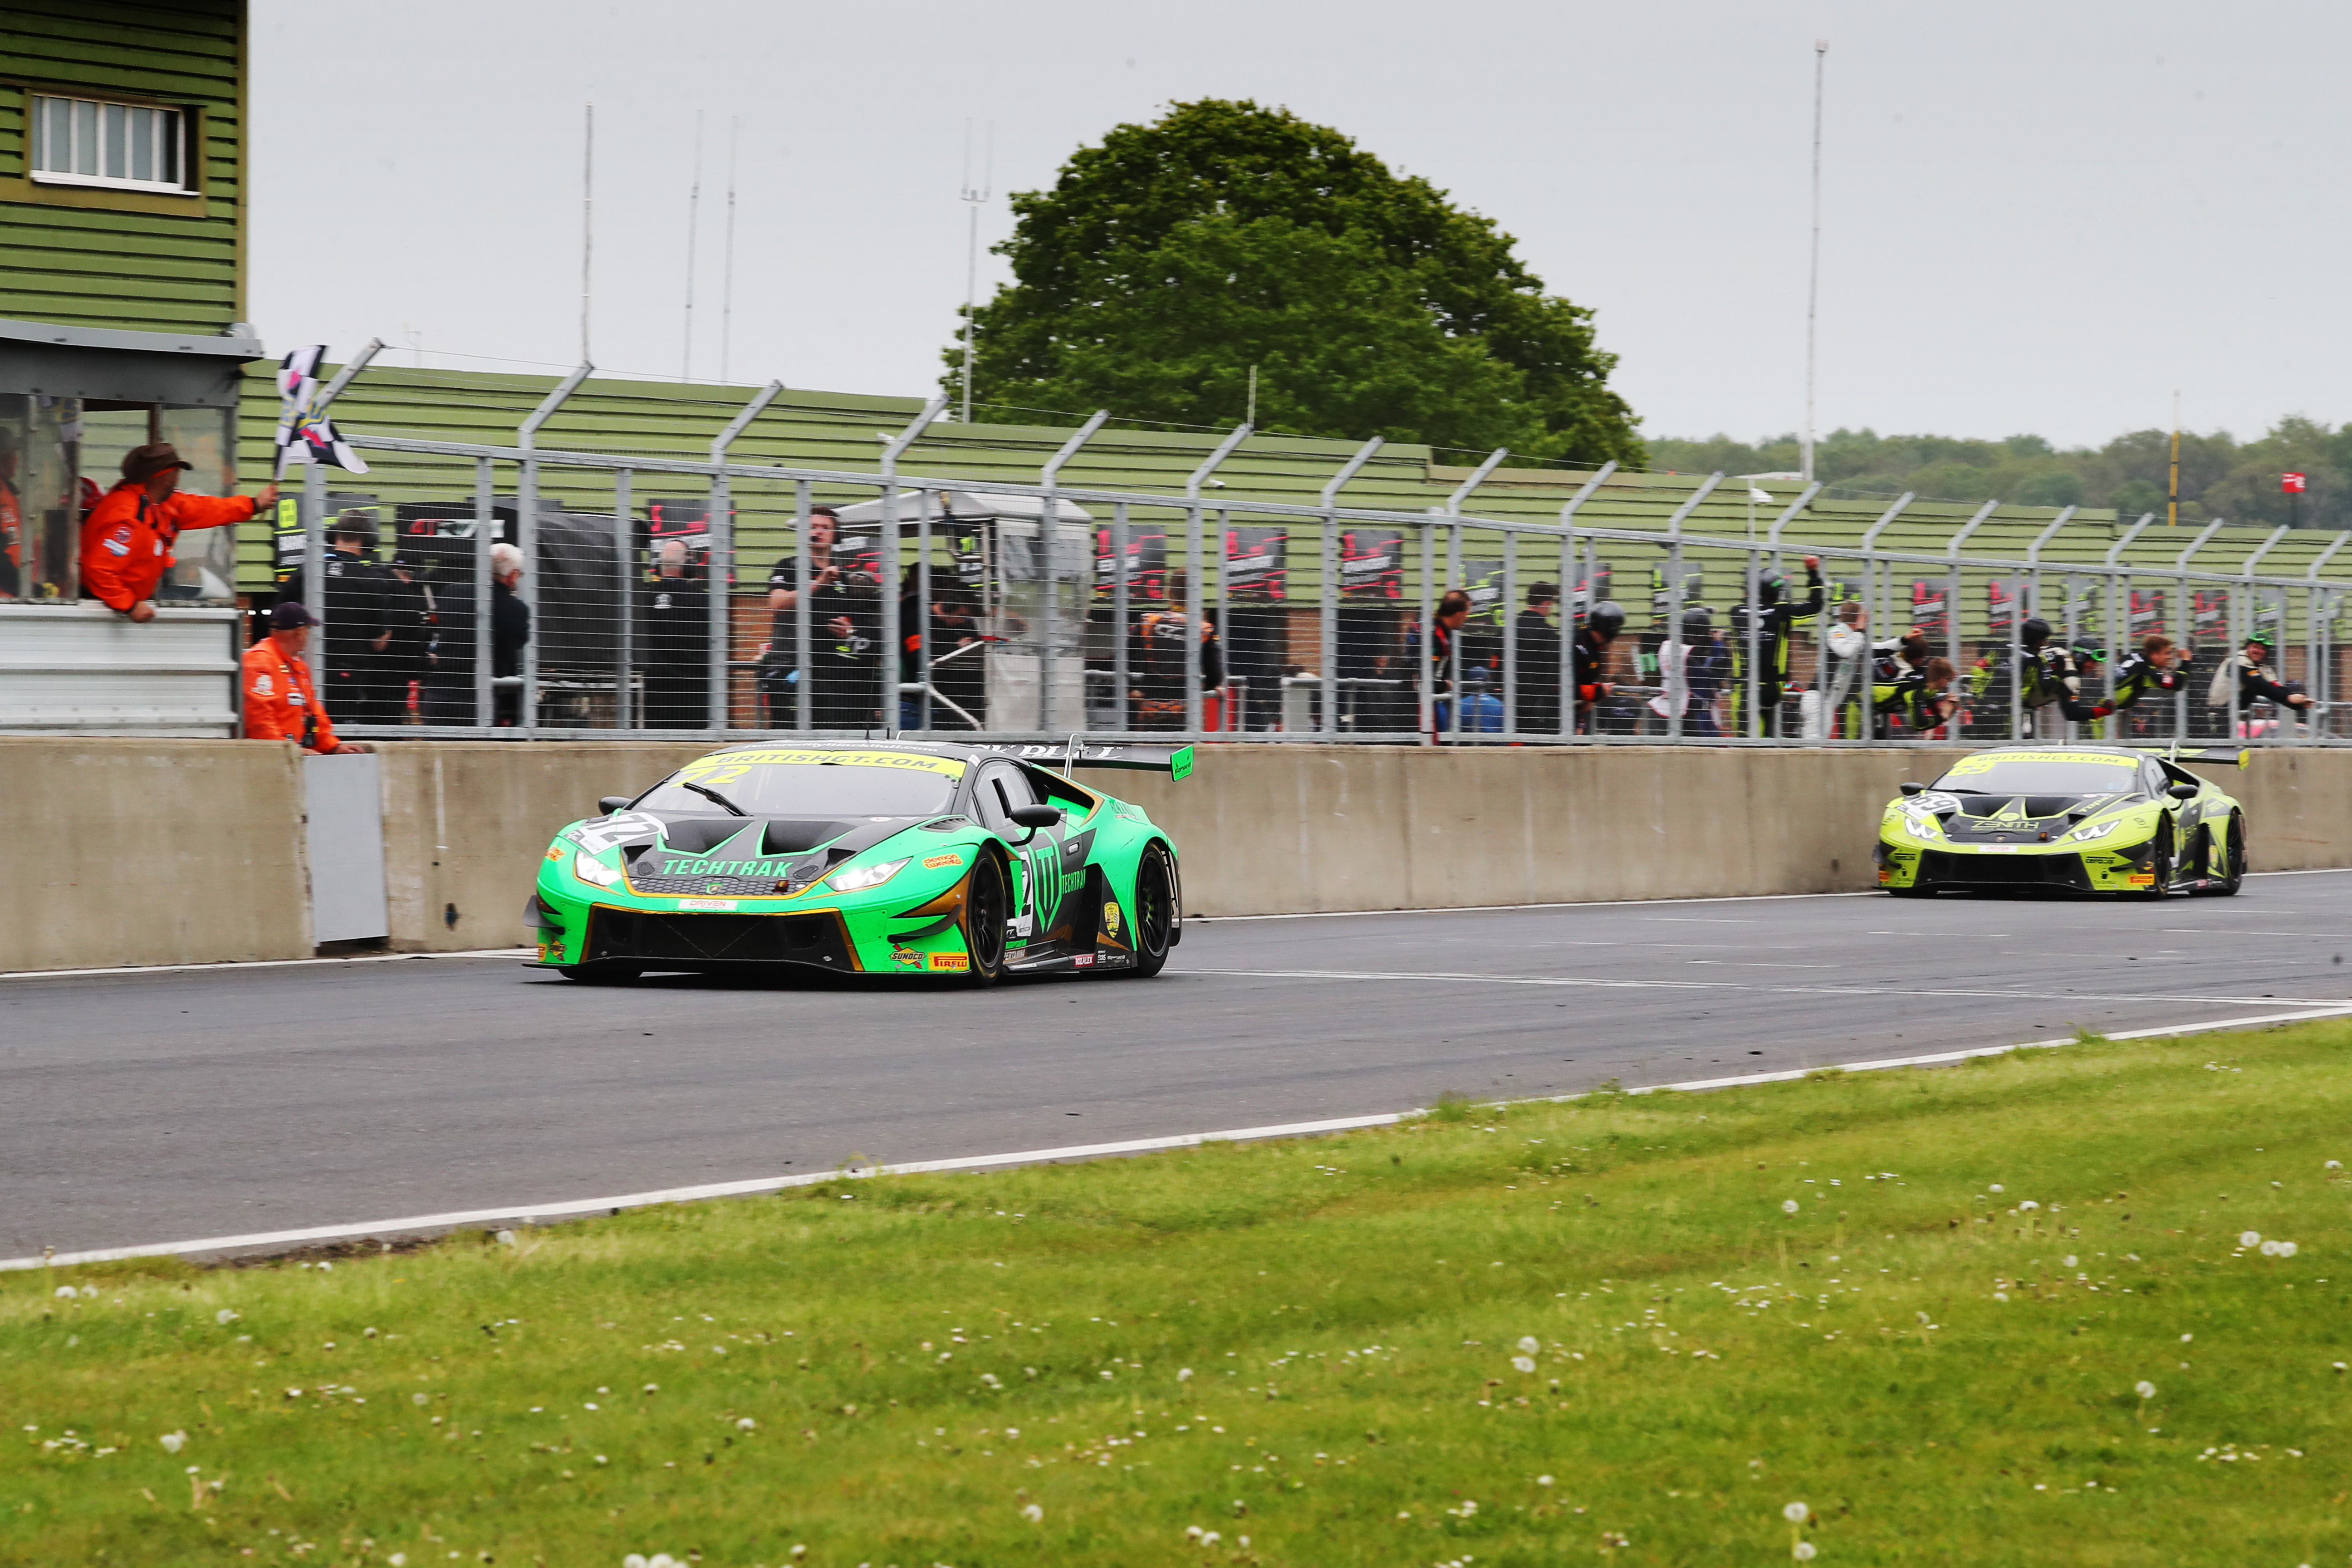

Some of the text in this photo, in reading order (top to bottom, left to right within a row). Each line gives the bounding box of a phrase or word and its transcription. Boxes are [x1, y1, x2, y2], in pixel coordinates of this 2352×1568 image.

[715, 754, 938, 769] BRITISHGT.COM
[1977, 755, 2120, 763] BRITISHGT.COM
[668, 765, 753, 788] 72
[1947, 762, 1997, 776] 69
[1909, 795, 1957, 811] 69
[585, 814, 660, 843] 72
[1971, 820, 2040, 829] ZENITH
[662, 859, 794, 877] TECHTRAK
[933, 956, 967, 967] PIRELLI
